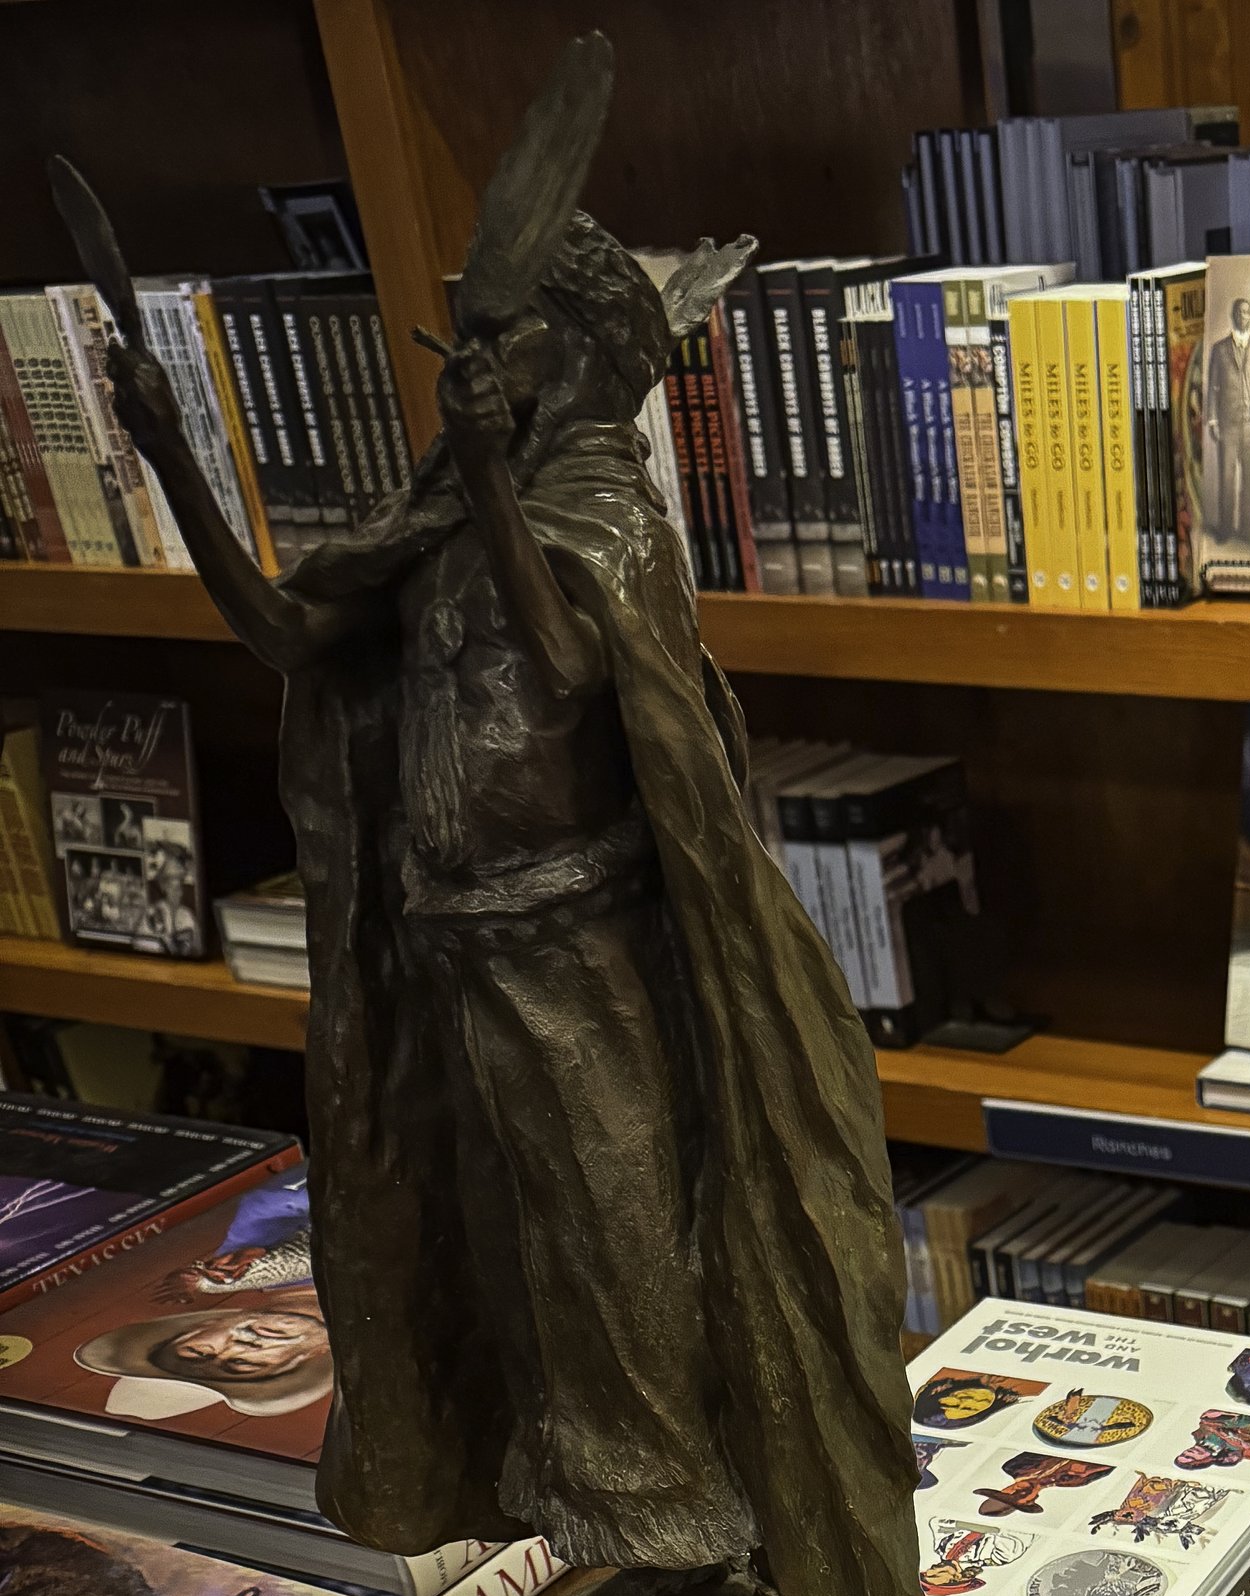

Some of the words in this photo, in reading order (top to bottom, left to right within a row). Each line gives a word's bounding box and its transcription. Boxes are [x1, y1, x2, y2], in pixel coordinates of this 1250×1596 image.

[732, 309, 752, 351] BLACK
[773, 309, 793, 351] BLACK
[738, 354, 759, 415] COWBOYS
[779, 354, 799, 415] COWBOYS
[1019, 362, 1036, 418] MILES
[1047, 363, 1063, 418] MILES
[748, 418, 761, 433] OF
[787, 418, 801, 433] OF
[1024, 424, 1033, 438] to
[1050, 424, 1061, 439] to
[1024, 442, 1039, 469] GO
[1052, 443, 1066, 471] GO
[982, 1320, 1096, 1346] west
[1105, 1335, 1137, 1344] THE
[960, 1335, 1140, 1372] warhol
[1104, 1344, 1141, 1353] AND
